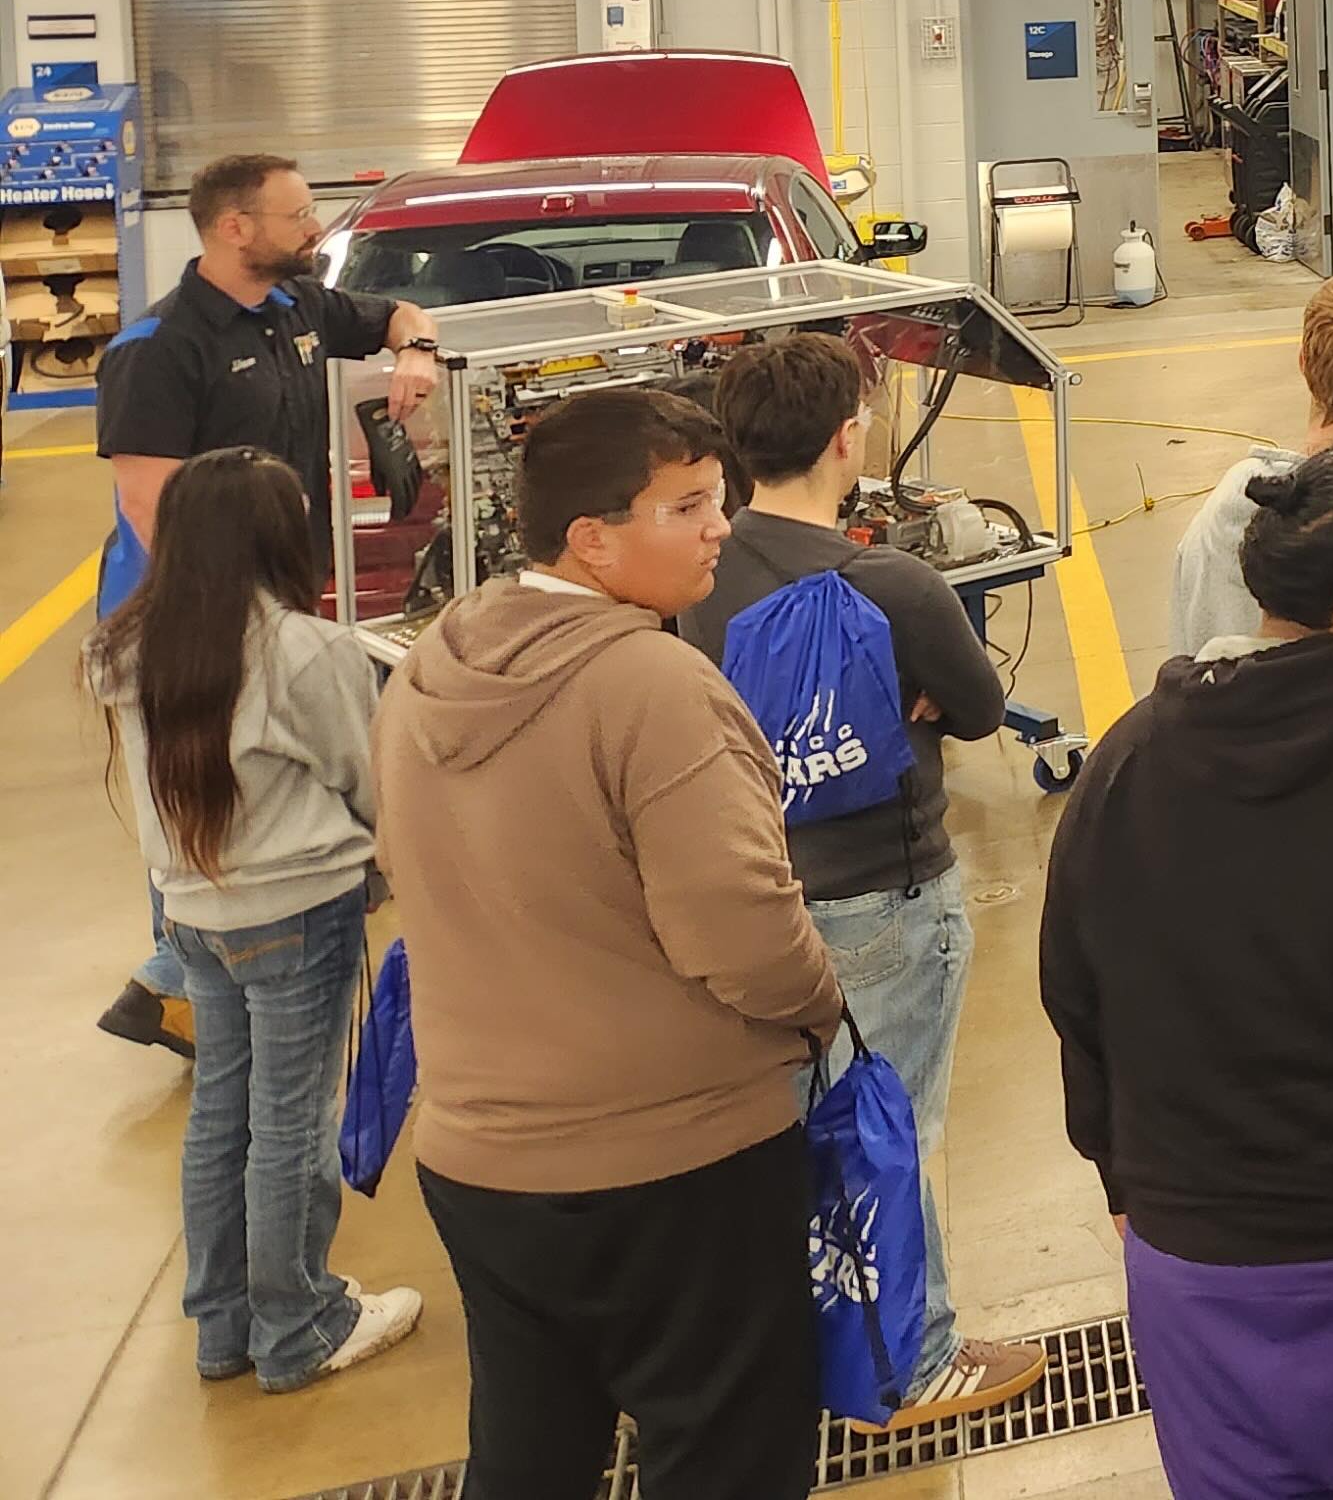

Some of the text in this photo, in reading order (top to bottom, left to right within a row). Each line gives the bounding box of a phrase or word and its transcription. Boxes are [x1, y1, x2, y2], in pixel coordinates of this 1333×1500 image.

[1029, 25, 1046, 35] 12C
[35, 66, 52, 78] 24
[0, 185, 59, 205] Heater
